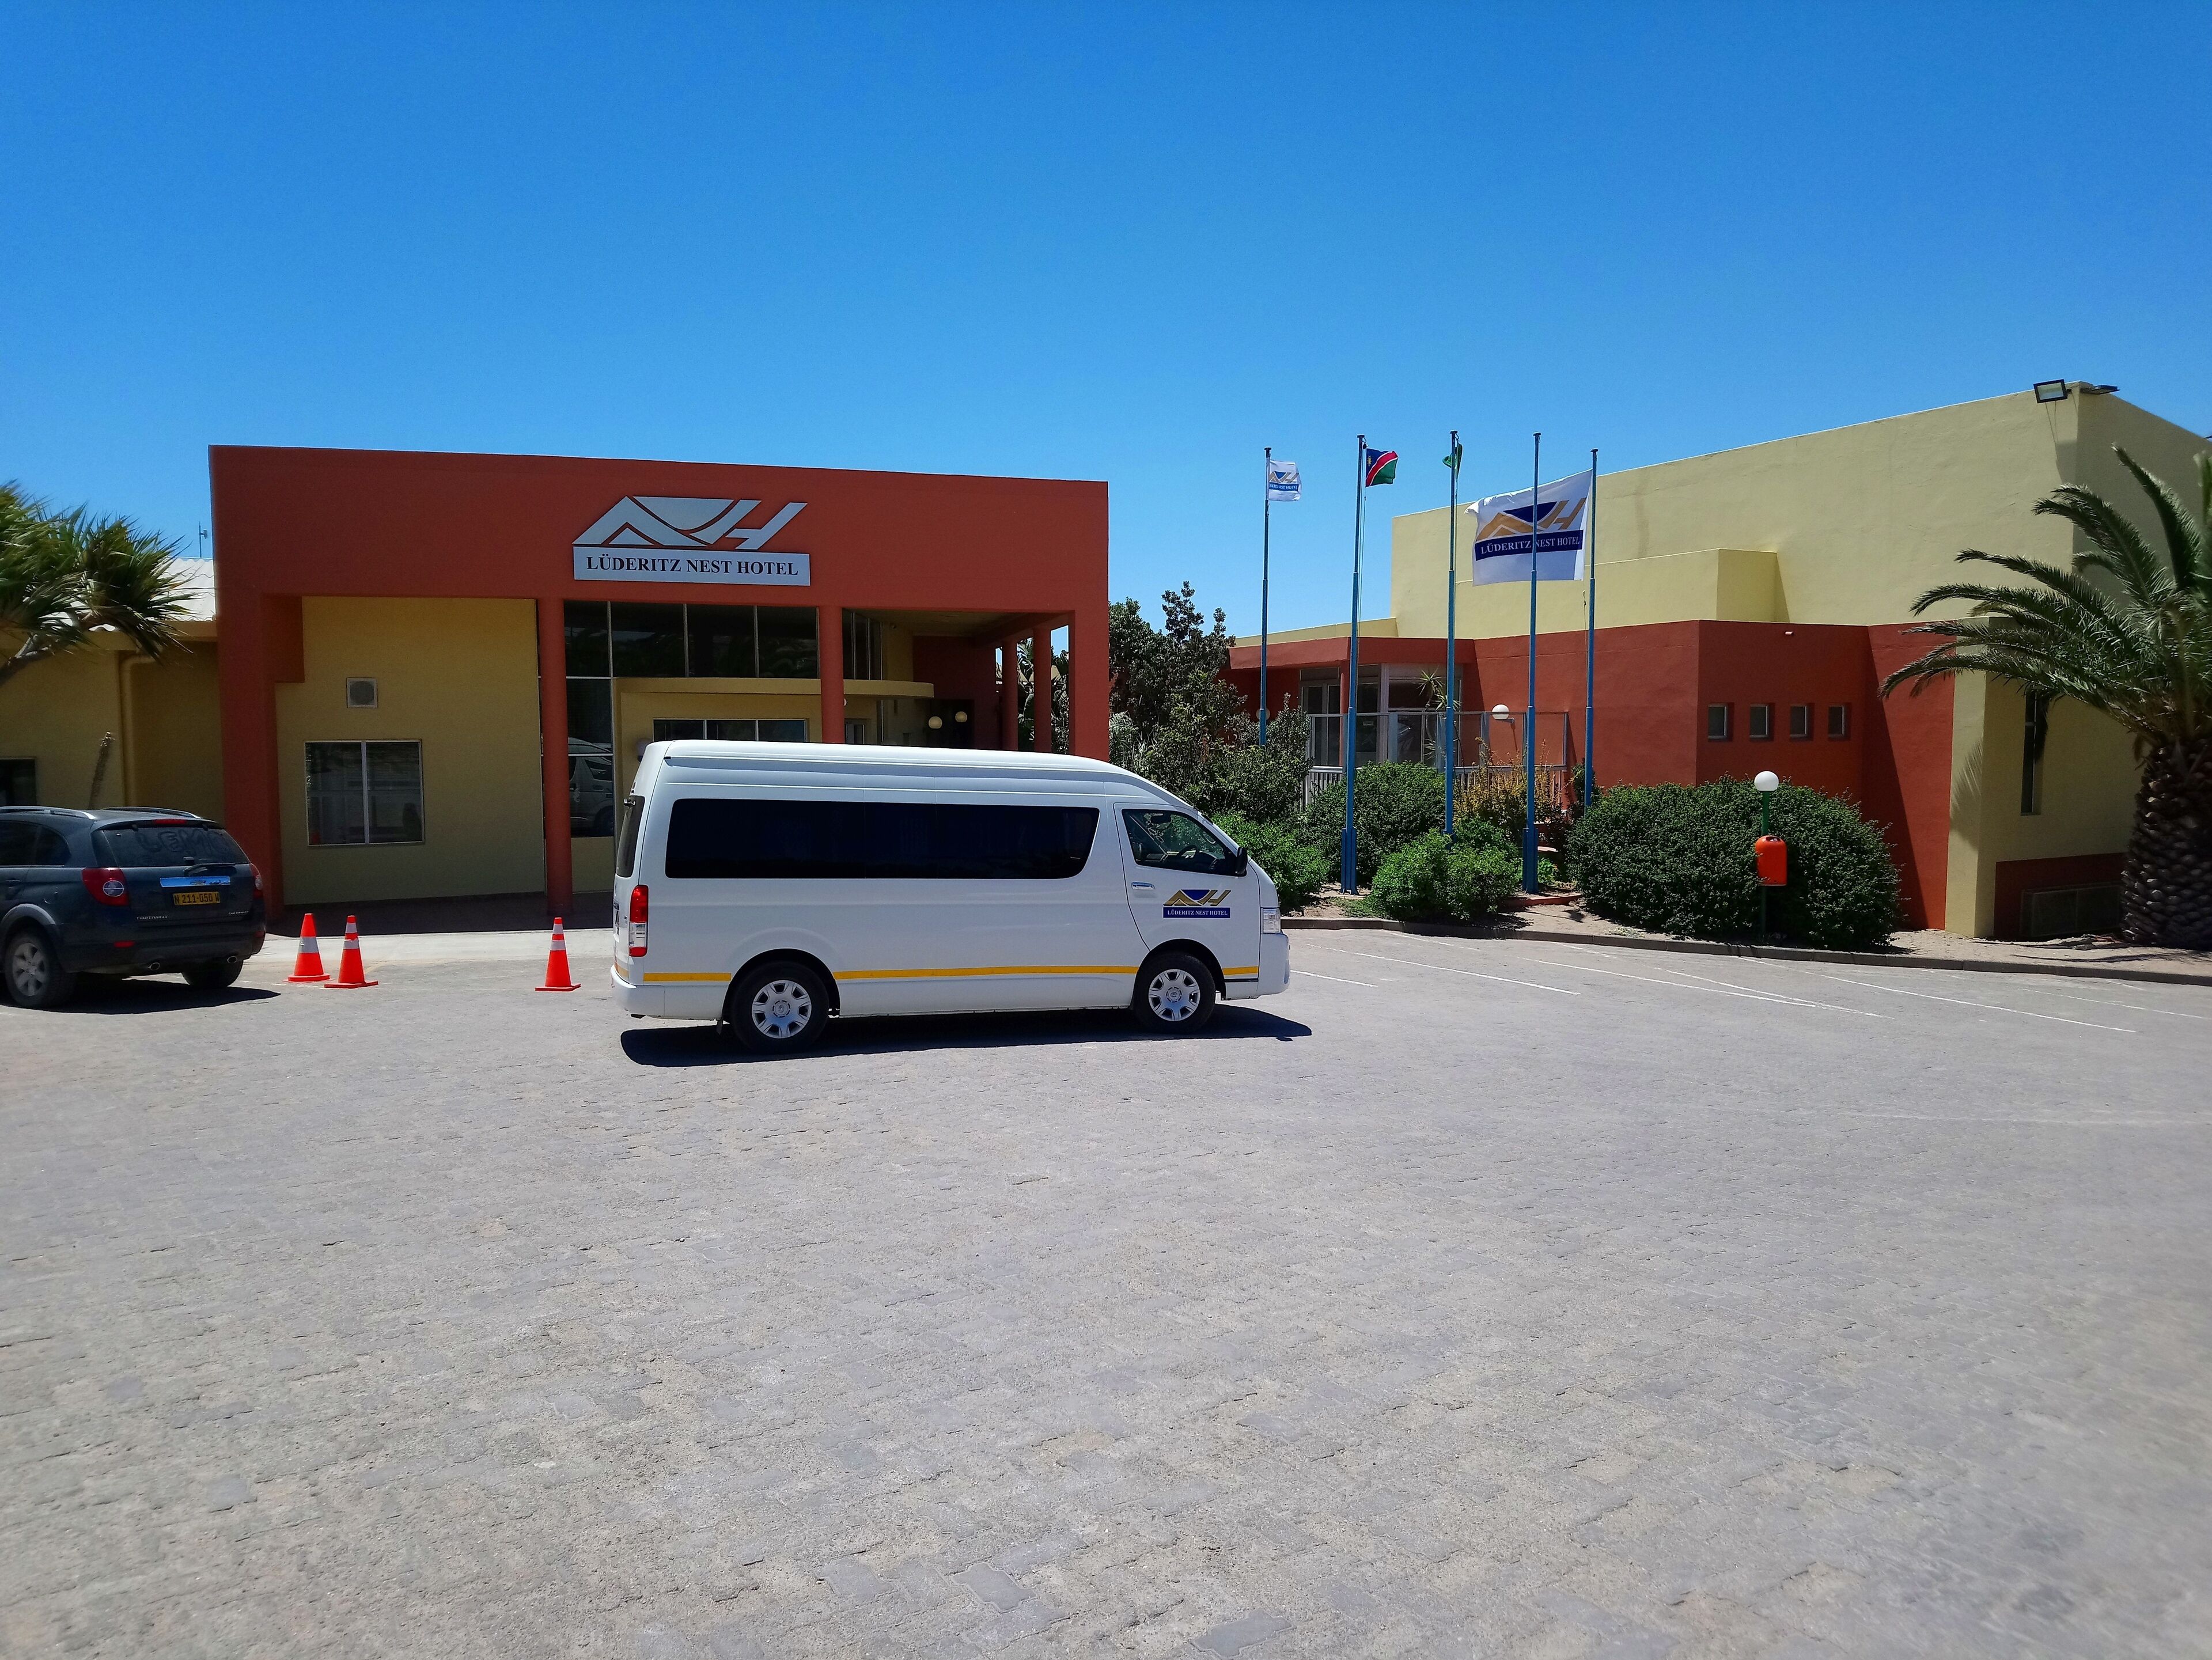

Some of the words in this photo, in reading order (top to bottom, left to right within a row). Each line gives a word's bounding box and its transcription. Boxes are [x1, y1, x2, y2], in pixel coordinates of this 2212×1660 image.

[1481, 540, 1532, 555] LÜDERITZ
[1557, 536, 1580, 546] HOTEL
[586, 554, 681, 573] LÜDERITZ
[687, 559, 732, 574] NEST
[737, 561, 798, 575] HOTEL
[175, 895, 180, 904] N
[182, 893, 213, 903] 211-050
